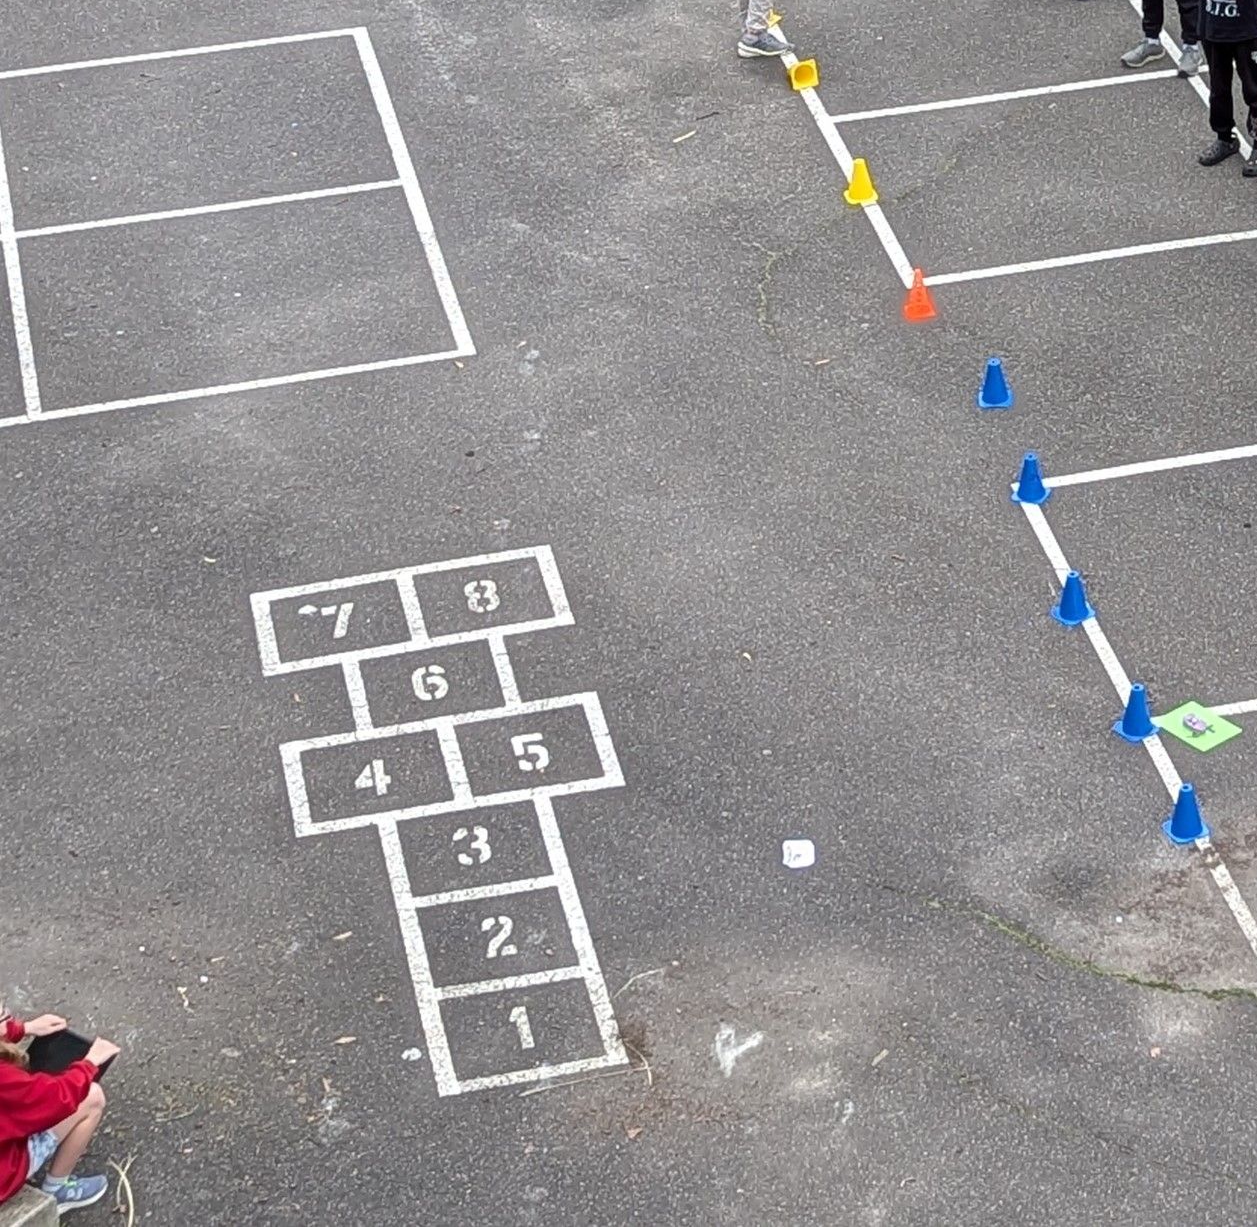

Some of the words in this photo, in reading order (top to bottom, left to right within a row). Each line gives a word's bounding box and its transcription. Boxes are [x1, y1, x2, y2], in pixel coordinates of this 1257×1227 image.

[464, 579, 501, 614] 8
[320, 602, 354, 639] 7
[411, 665, 449, 701] 6
[511, 732, 550, 771] 5
[354, 759, 392, 796] 4
[452, 826, 492, 866] 3
[481, 915, 518, 959] 2
[509, 1005, 535, 1050] 1
